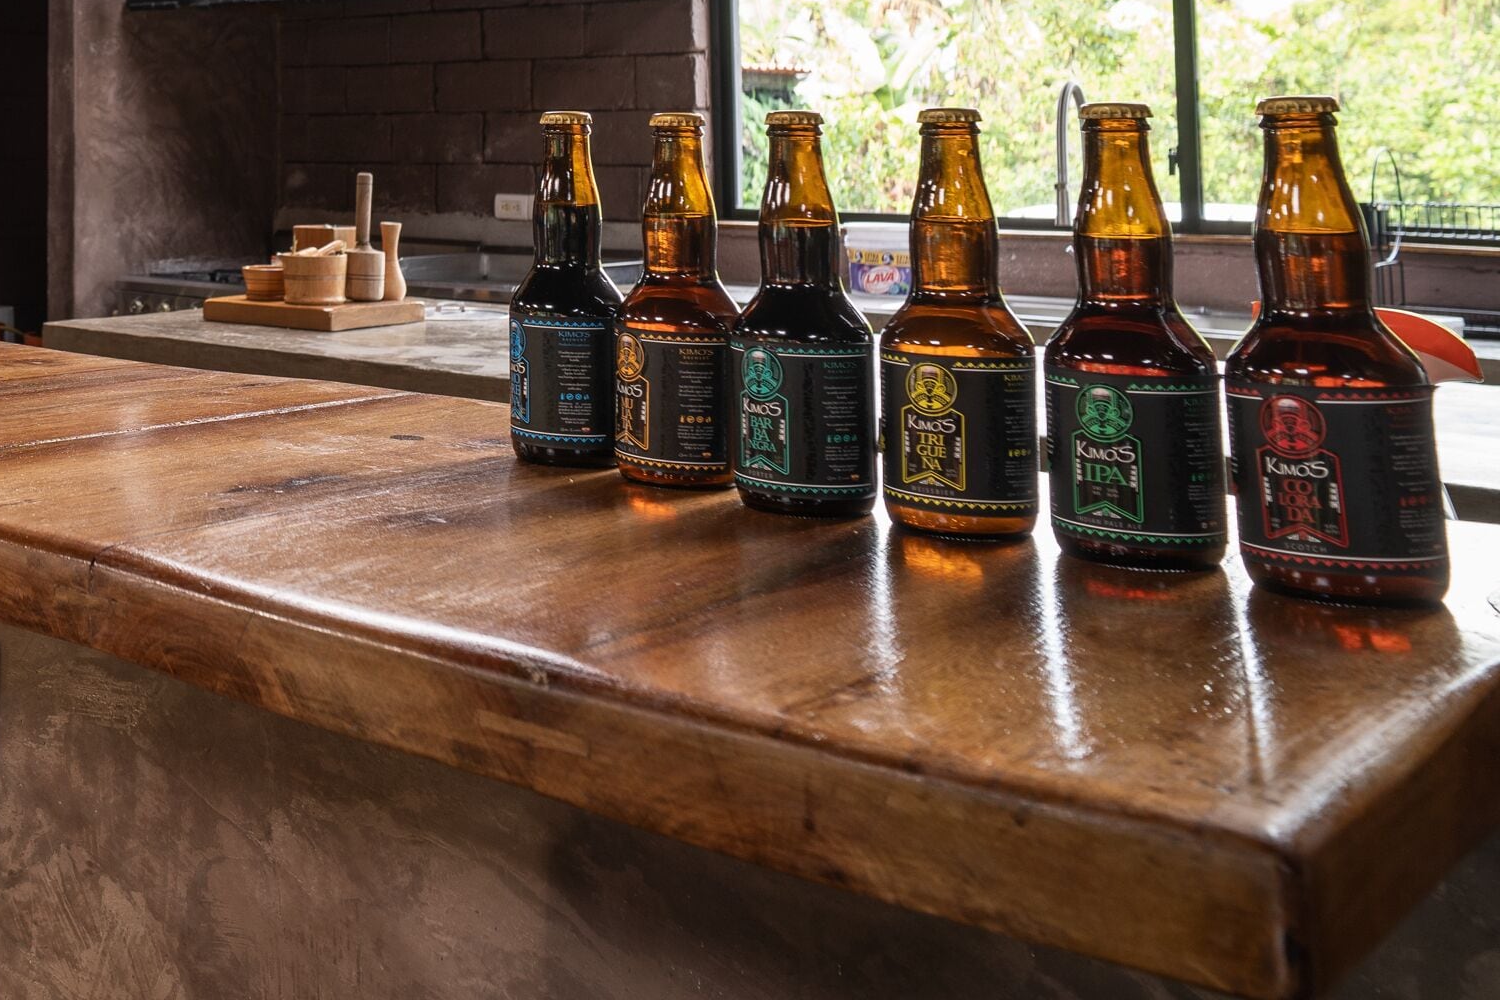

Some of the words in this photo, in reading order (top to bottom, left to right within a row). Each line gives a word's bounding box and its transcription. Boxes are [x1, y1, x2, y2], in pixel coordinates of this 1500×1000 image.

[866, 272, 895, 284] LAVA
[750, 415, 774, 430] BAR
[753, 428, 771, 443] BA
[916, 432, 945, 447] TRI
[748, 439, 777, 453] NEGRA
[916, 444, 948, 459] GUE
[1084, 462, 1128, 487] IPA
[1282, 479, 1313, 495] CO
[1277, 492, 1323, 509] LORA
[1286, 506, 1316, 524] DA
[1284, 542, 1328, 553] SCOTCH
